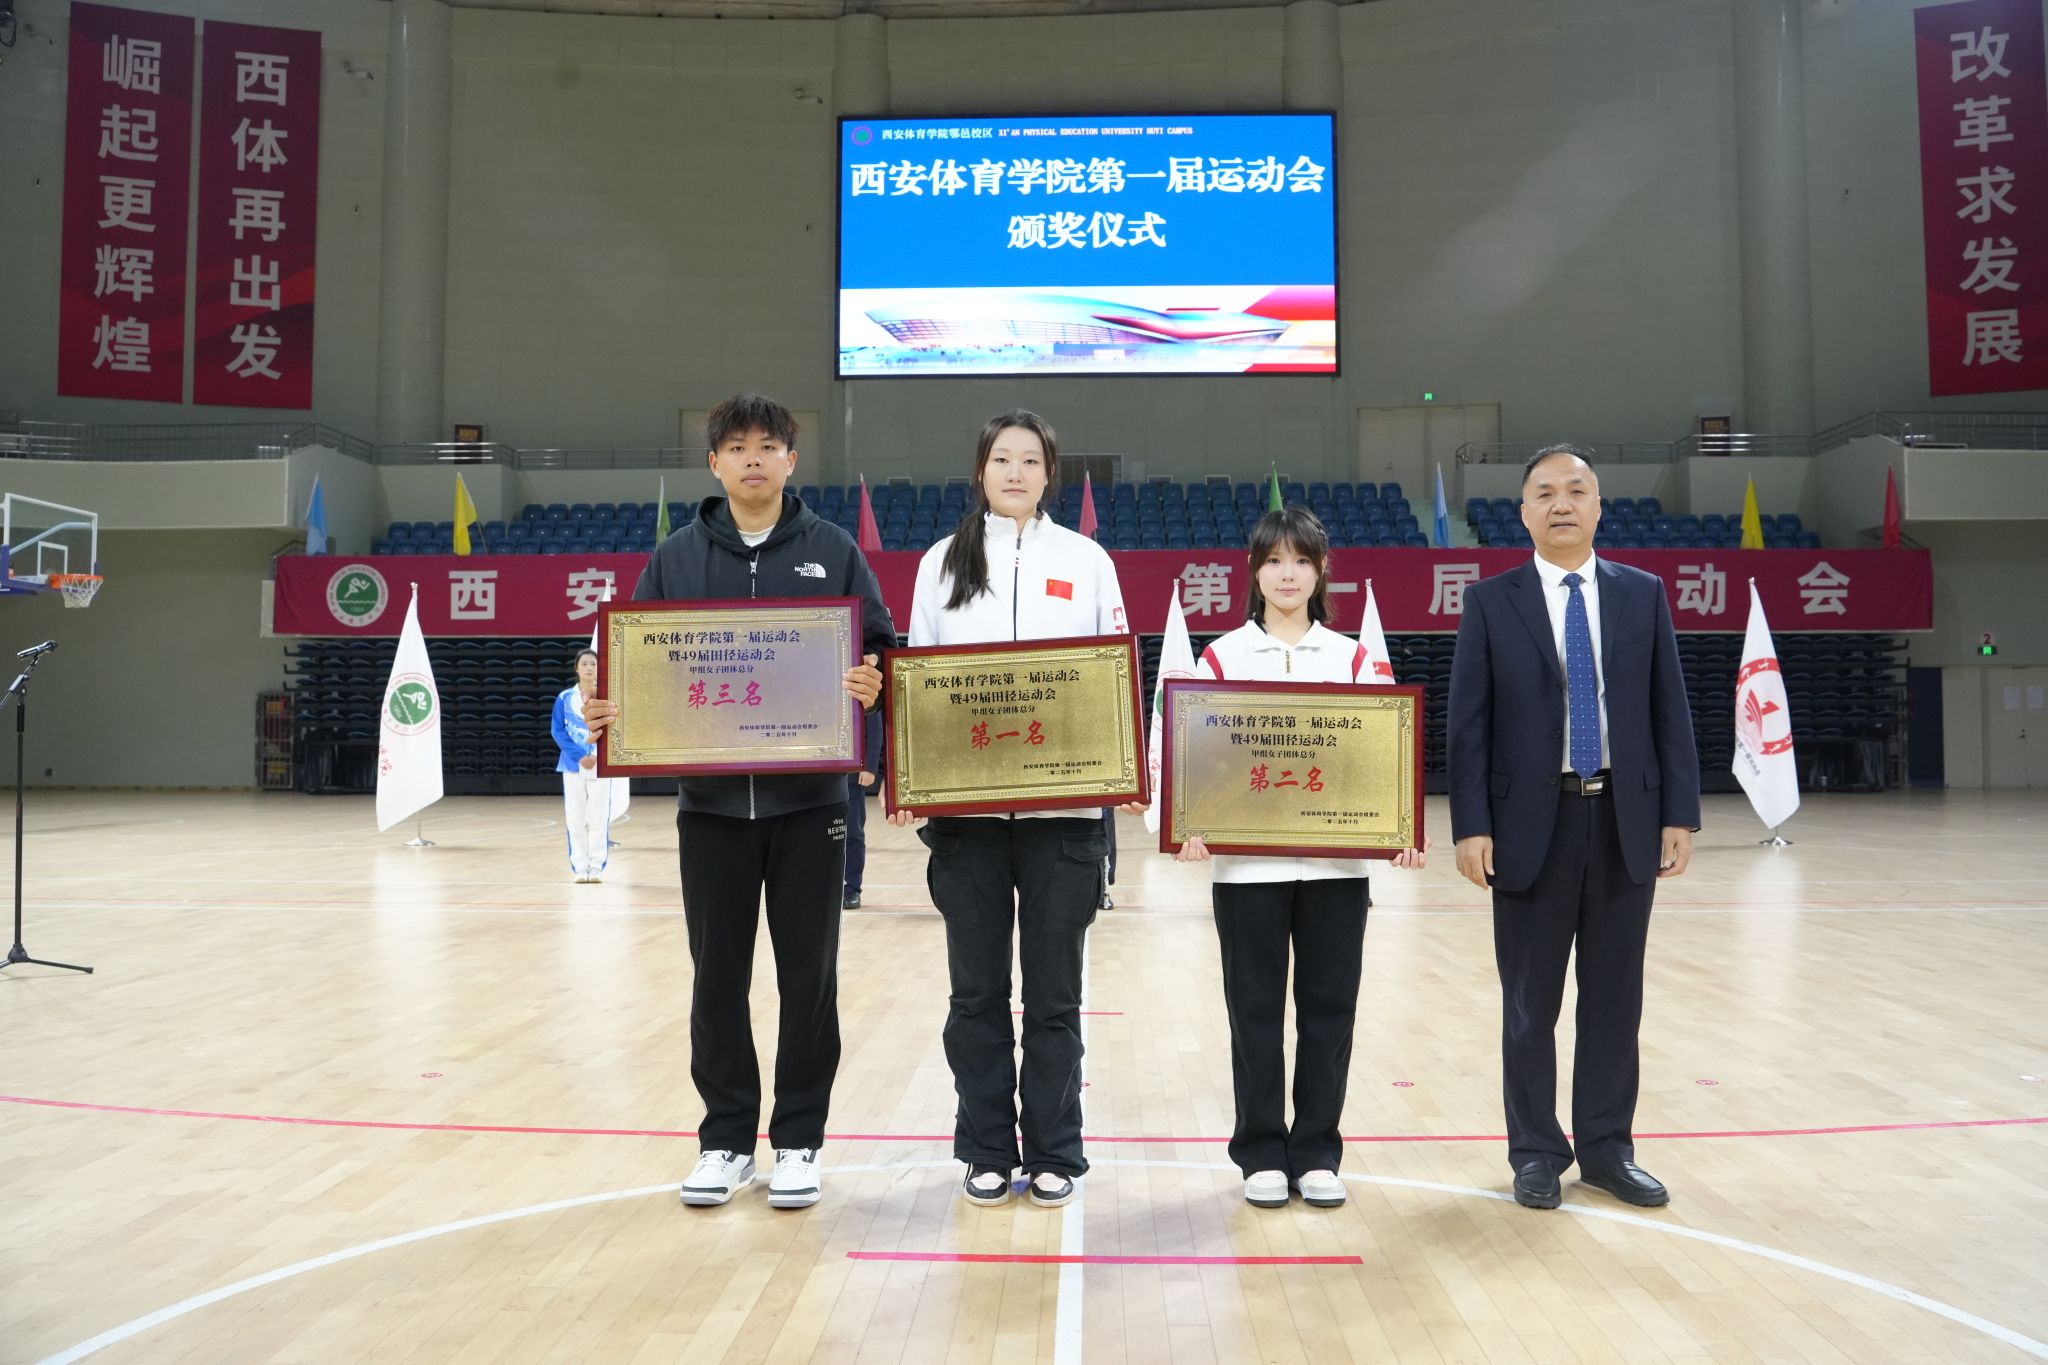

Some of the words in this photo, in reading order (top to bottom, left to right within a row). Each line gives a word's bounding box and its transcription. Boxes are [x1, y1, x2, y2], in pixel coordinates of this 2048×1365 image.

[1023, 128, 1057, 136] PHYSICAL
[1060, 127, 1099, 136] EDUCATION
[1101, 127, 1144, 135] UNIVERSITY
[1166, 126, 1194, 135] CAMPUS
[850, 156, 1326, 196] 西安体育学院第一届运动会
[92, 34, 162, 373] 崛起更辉煌
[1950, 26, 2023, 367] 改革求发展
[225, 51, 290, 381] 西体再出发
[1007, 211, 1167, 249] 颁奖仪式
[643, 630, 801, 646] 西安体育学院第一届运动会
[1983, 633, 1992, 645] 2
[668, 648, 776, 662] 暨49届田径运动会
[689, 664, 754, 675] 甲组女子团体总分
[924, 669, 1080, 690] 西安体育学院第一届运动会
[687, 679, 763, 711] 第三名
[950, 687, 1057, 706] 暨49届田径运动会
[971, 704, 1036, 716] 甲组女子团体总分
[1205, 714, 1363, 730] 西安体育学院第一届运动会
[969, 720, 1045, 750] 第一名
[1230, 732, 1338, 748] 暨49届田径运动会
[1251, 749, 1316, 759] 甲组女子团体总分
[1249, 763, 1324, 794] 第二名
